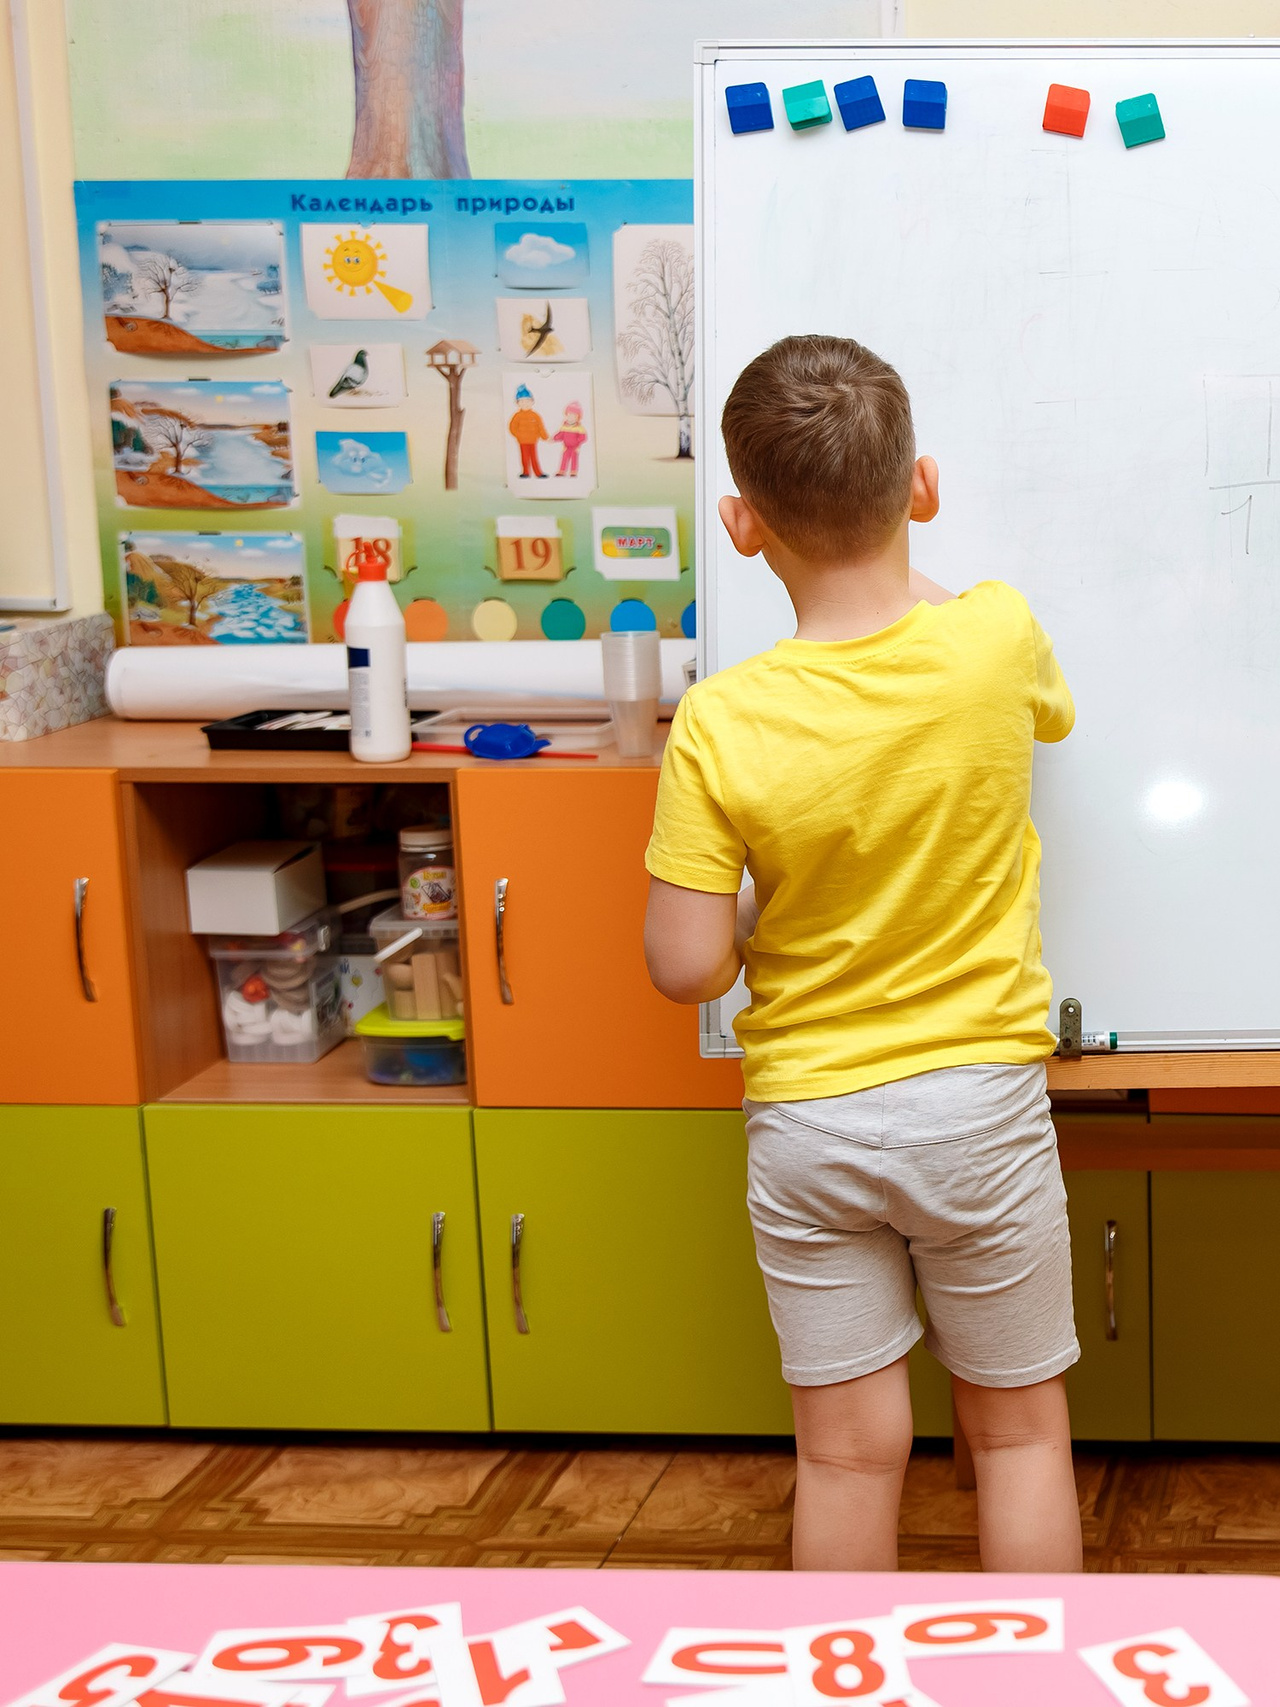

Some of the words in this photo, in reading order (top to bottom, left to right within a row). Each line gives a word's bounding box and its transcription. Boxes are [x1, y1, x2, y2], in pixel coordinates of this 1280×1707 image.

[291, 194, 433, 215] Календарь
[456, 196, 575, 215] природы
[510, 538, 553, 571] 19
[616, 536, 654, 548] МАРТ
[809, 1630, 885, 1698] 8
